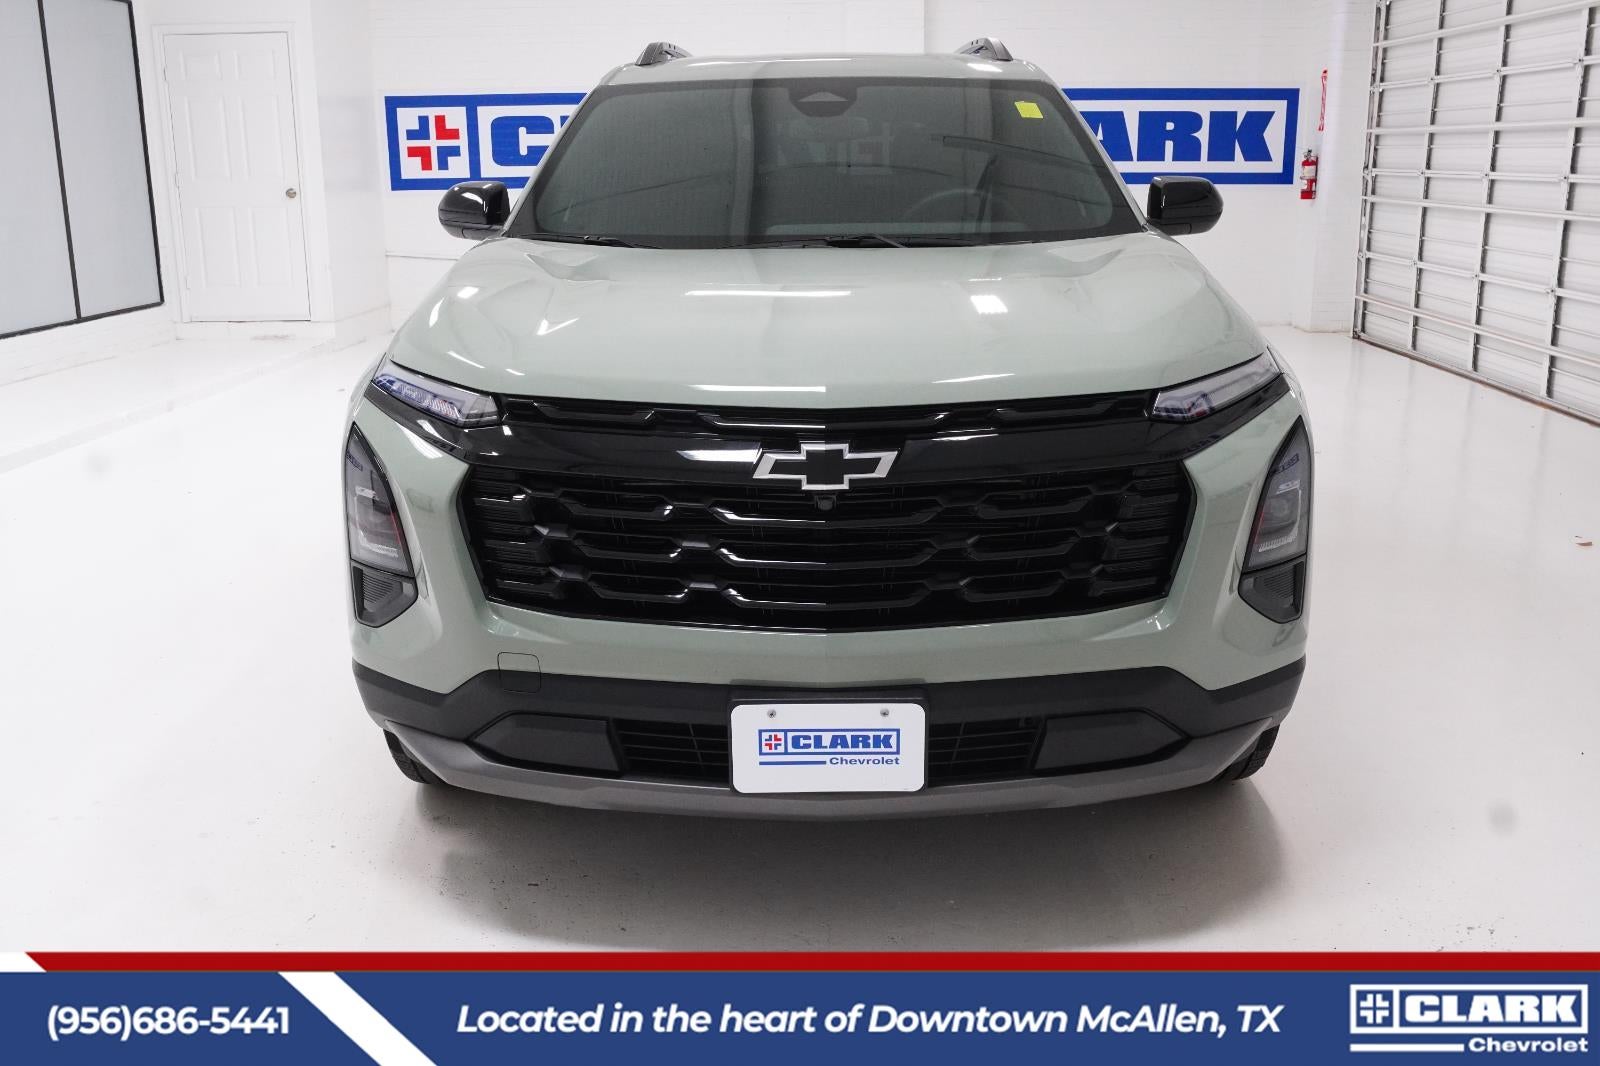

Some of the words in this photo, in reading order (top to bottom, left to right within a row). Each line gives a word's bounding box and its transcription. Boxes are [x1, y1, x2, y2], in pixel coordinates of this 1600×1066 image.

[490, 115, 570, 167] C
[791, 734, 893, 750] CLARK
[829, 757, 900, 766] Chevrolet
